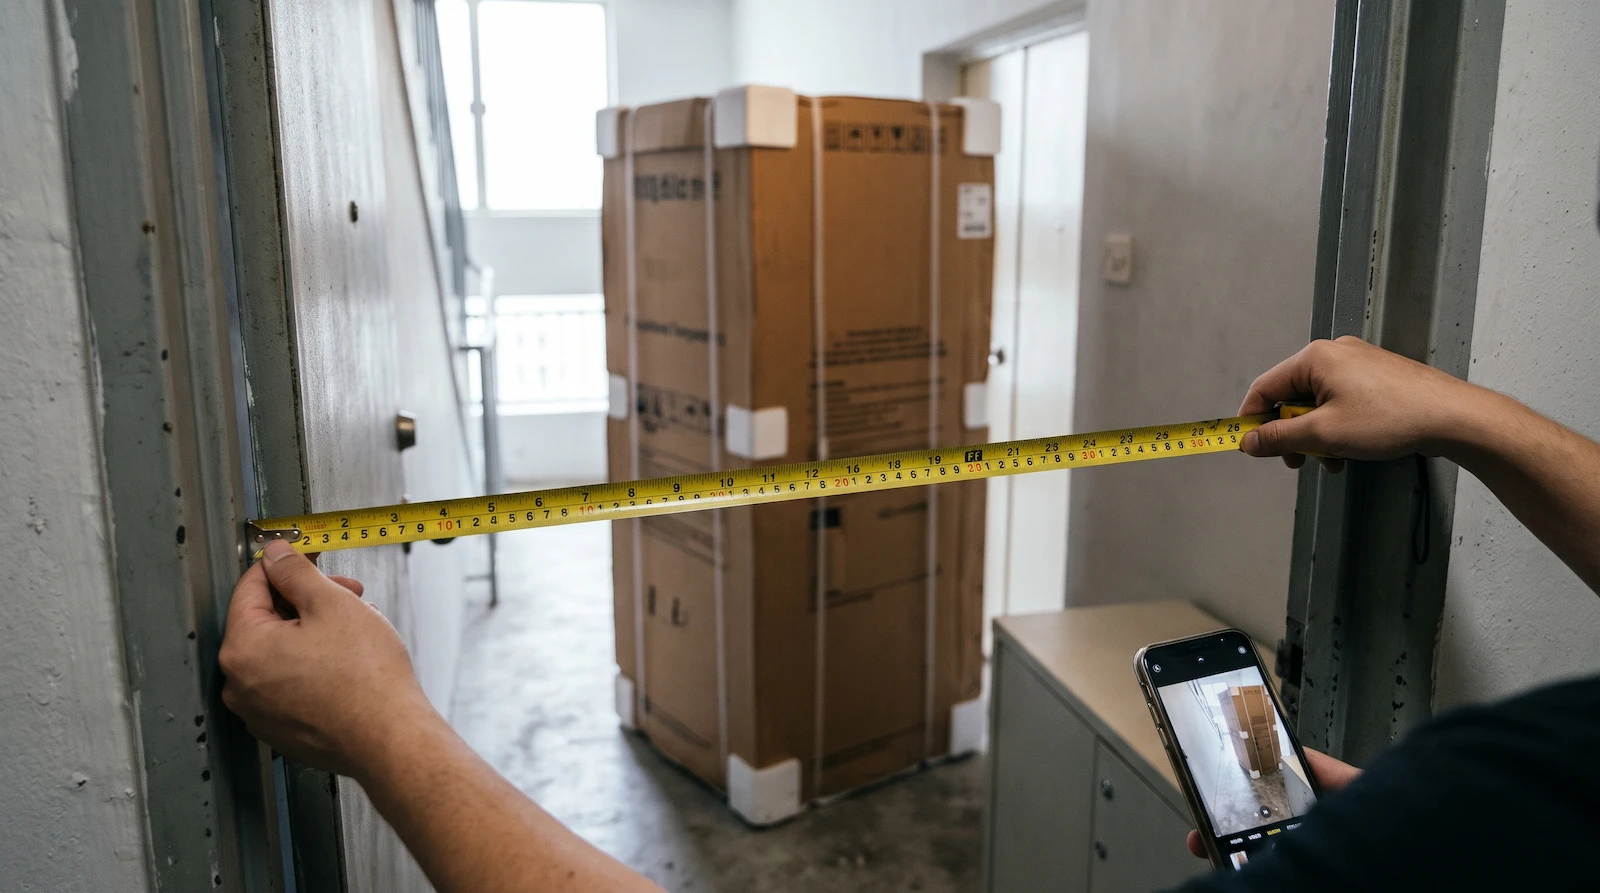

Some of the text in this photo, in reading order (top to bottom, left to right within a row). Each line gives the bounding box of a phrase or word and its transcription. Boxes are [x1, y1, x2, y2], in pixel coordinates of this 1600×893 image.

[303, 536, 310, 545] 2
[322, 534, 329, 543] 3
[341, 532, 348, 540] 4
[361, 530, 368, 539] 5
[380, 528, 387, 536] 6
[398, 525, 405, 534] 7
[417, 524, 424, 532] 9
[437, 520, 453, 531] 10
[456, 520, 461, 528] 1
[473, 518, 480, 526] 2
[509, 513, 516, 522] 5
[526, 512, 533, 520] 6
[544, 510, 550, 519] 7
[561, 508, 568, 517] 8
[580, 506, 594, 515] 10
[759, 487, 765, 495] 4
[774, 485, 780, 494] 5
[789, 483, 796, 492] 6
[804, 482, 810, 490] 7
[820, 481, 826, 489] 8
[835, 478, 849, 487] 20
[852, 477, 857, 485] 1
[866, 476, 872, 484] 2
[880, 474, 887, 482] 3
[895, 472, 902, 480] 4
[911, 471, 917, 479] 6
[925, 469, 931, 477] 7
[940, 467, 946, 475] 8
[954, 466, 960, 474] 9
[968, 463, 982, 472] 20
[985, 462, 990, 470] 1
[999, 461, 1005, 469] 2
[1013, 459, 1019, 467] 5
[1027, 458, 1033, 466] 6
[1041, 456, 1046, 464] 7
[1055, 455, 1061, 463] 8
[1069, 453, 1075, 461] 9
[1082, 451, 1095, 459] 30
[1111, 448, 1116, 457] 2
[1124, 447, 1130, 455] 3
[1138, 445, 1144, 453] 4
[1231, 435, 1236, 443] 3
[341, 518, 349, 528] 2
[391, 513, 399, 522] 3
[440, 508, 447, 517] 4
[488, 503, 495, 512] 5
[535, 498, 543, 507] 6
[582, 492, 589, 502] 7
[628, 488, 635, 497] 8
[673, 483, 680, 492] 9
[720, 478, 734, 487] 10
[762, 473, 775, 482] 11
[805, 469, 819, 478] 12
[847, 465, 860, 474] 16
[888, 460, 901, 469] 18
[928, 456, 941, 465] 19
[1007, 448, 1019, 456] 21
[1083, 439, 1096, 448] 24
[1120, 435, 1133, 444] 23
[1227, 423, 1240, 432] 26
